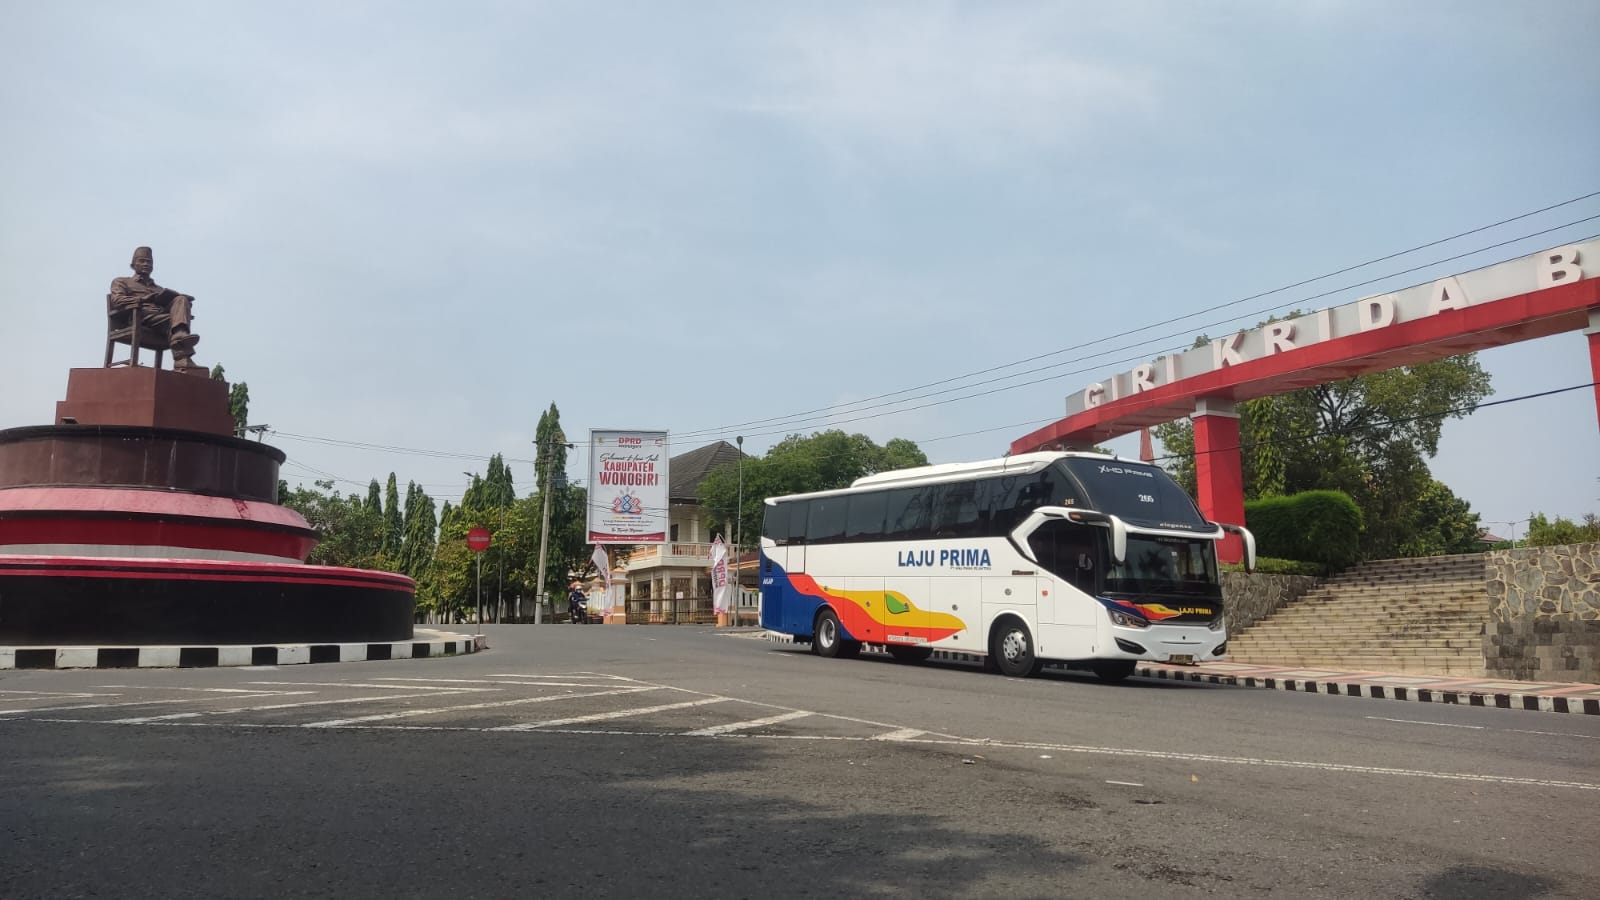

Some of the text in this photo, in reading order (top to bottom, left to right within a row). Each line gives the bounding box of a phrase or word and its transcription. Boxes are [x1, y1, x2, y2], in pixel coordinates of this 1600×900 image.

[1084, 354, 1182, 410] GIRI
[1212, 276, 1471, 371] KRIDA
[604, 462, 654, 472] KABUPATEN
[1098, 465, 1123, 474] XHD
[599, 472, 659, 486] WONOGIRI
[898, 549, 991, 567] LAJU PRIMA
